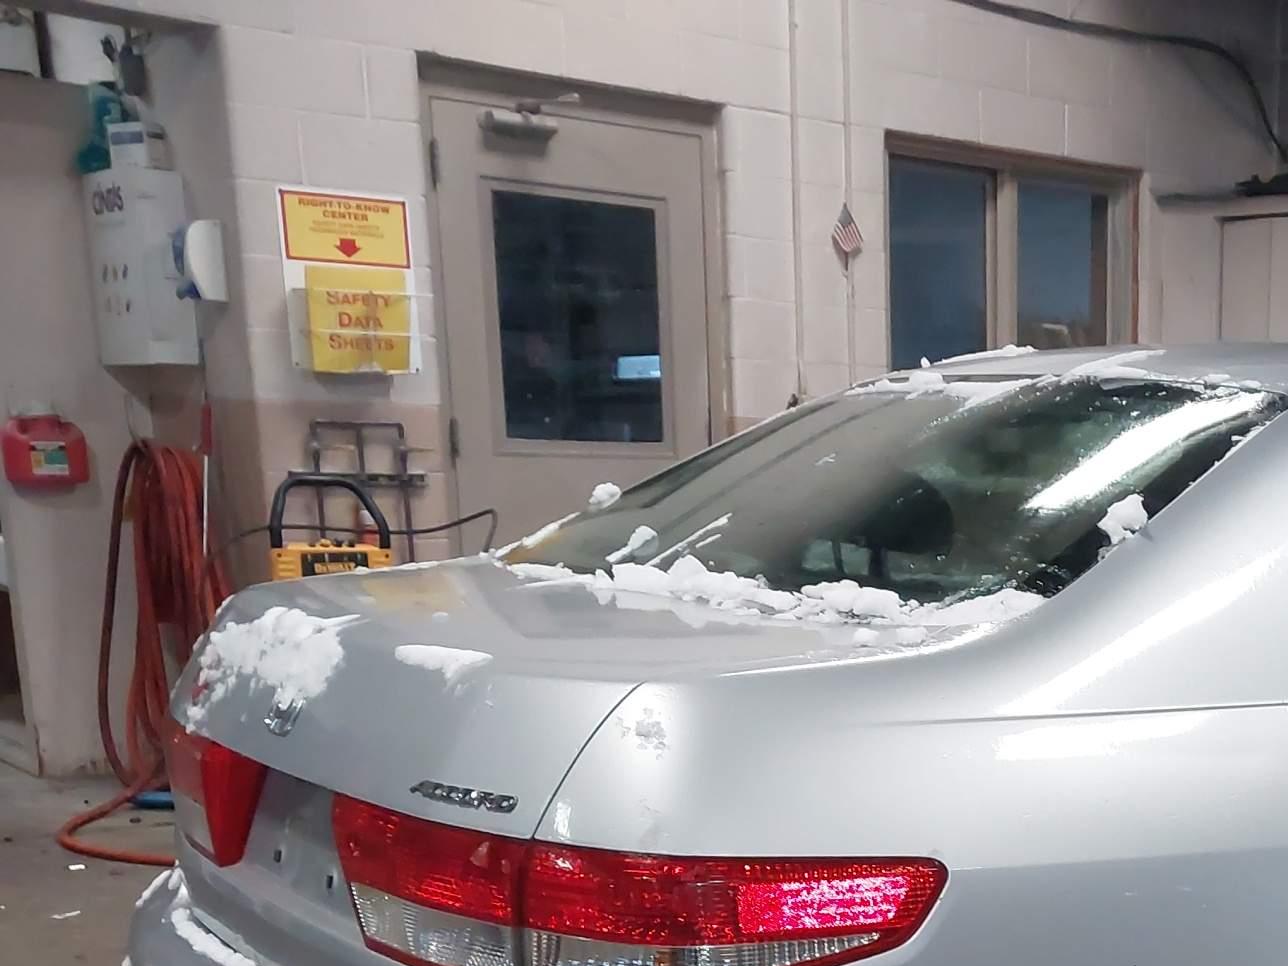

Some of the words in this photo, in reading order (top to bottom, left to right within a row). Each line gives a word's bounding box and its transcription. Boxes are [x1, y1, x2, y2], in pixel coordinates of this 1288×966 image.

[322, 210, 368, 222] CENTER
[326, 290, 391, 308] SAFETY
[338, 312, 383, 329] DATA
